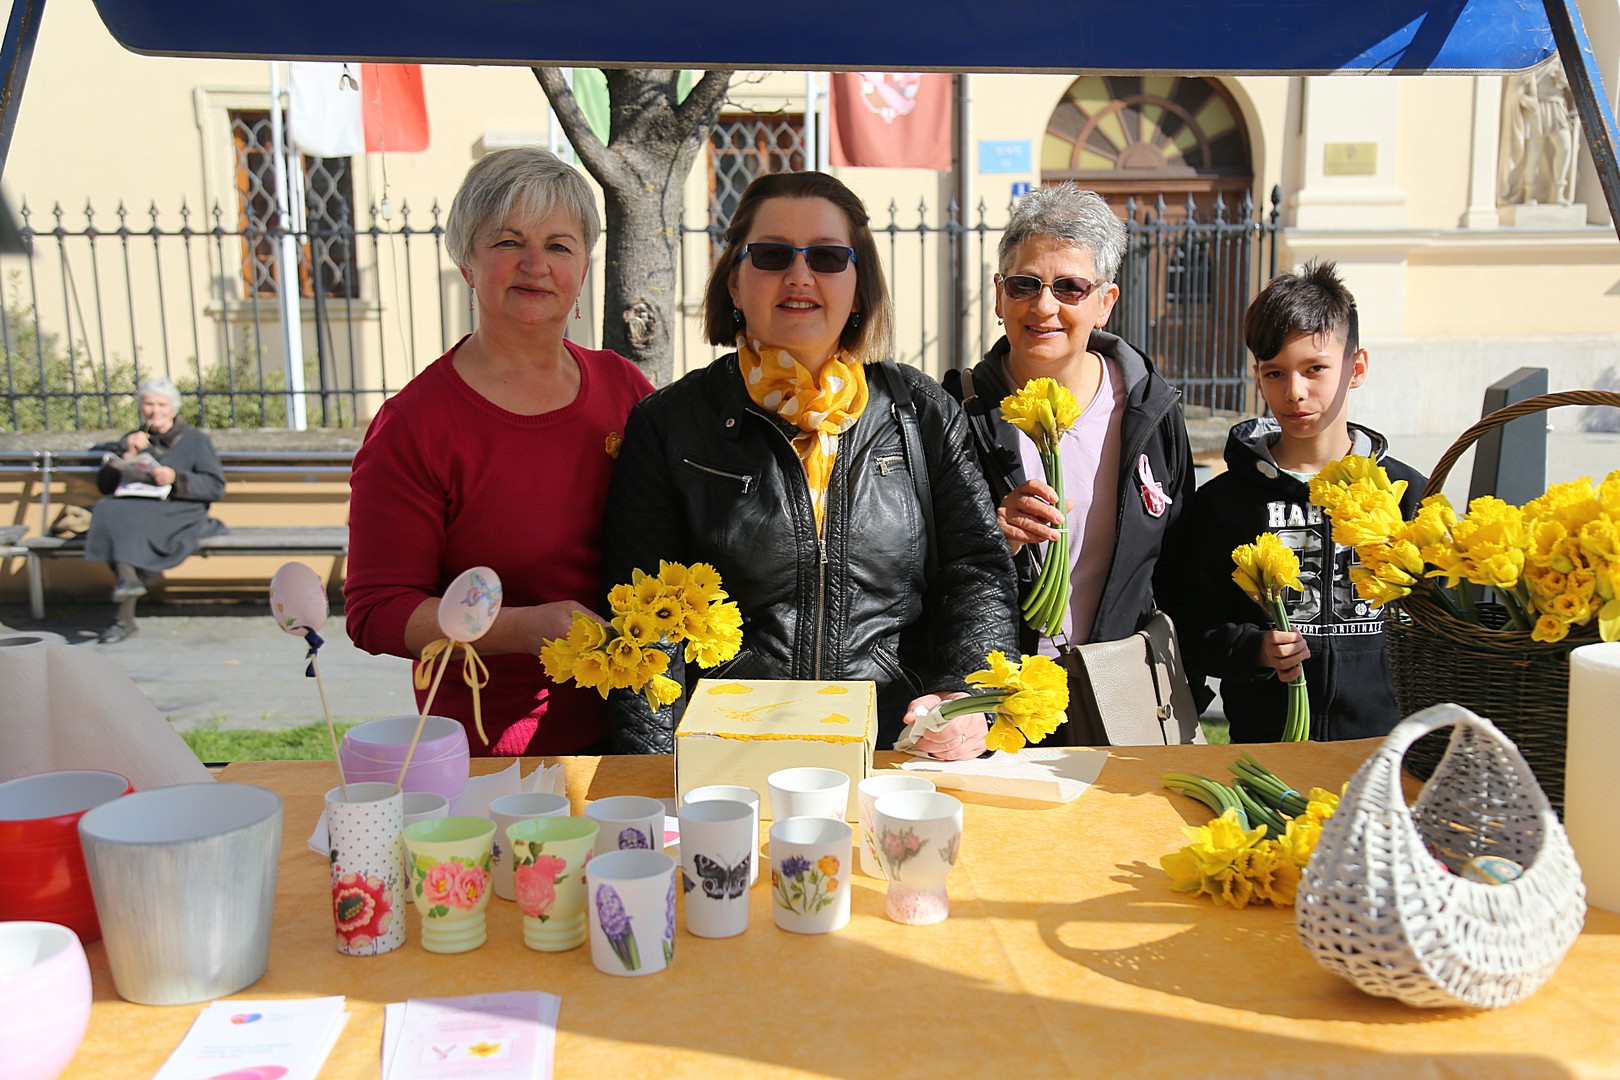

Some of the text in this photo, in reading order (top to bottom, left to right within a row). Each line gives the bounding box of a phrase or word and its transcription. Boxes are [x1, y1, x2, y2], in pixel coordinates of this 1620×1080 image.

[1267, 501, 1324, 527] HAR
[1297, 623, 1382, 634] PORT ORIGINALS
